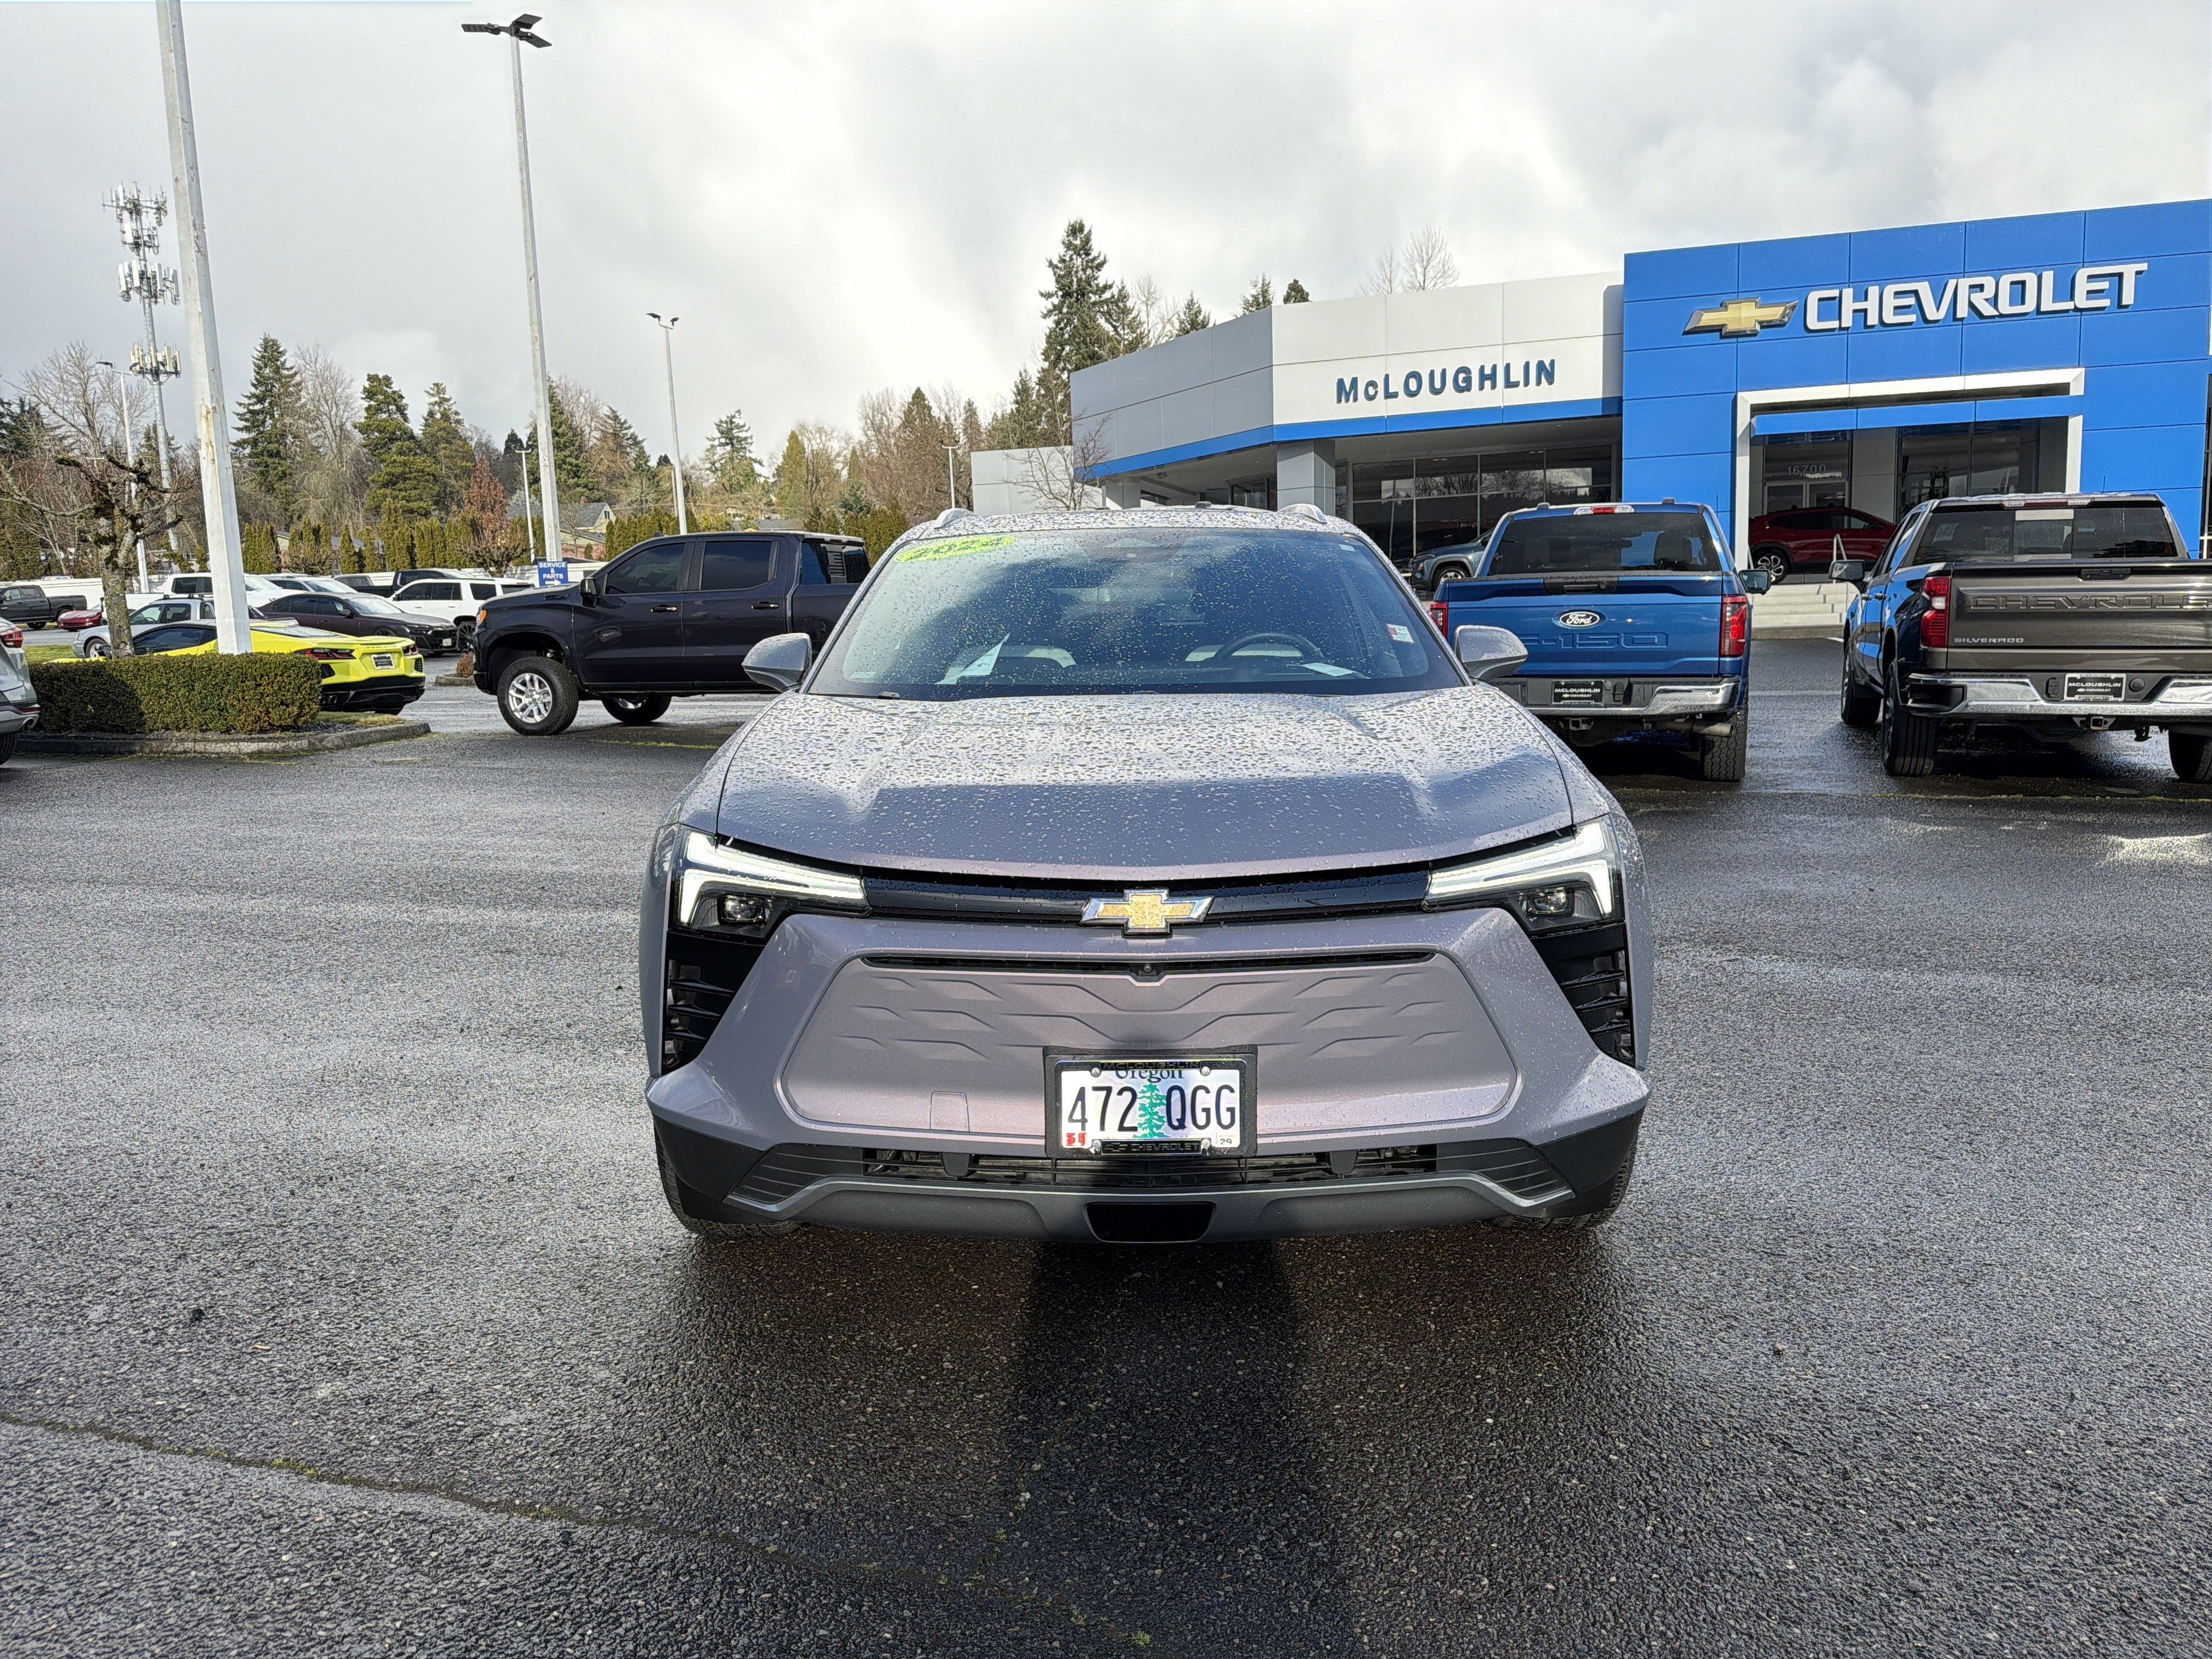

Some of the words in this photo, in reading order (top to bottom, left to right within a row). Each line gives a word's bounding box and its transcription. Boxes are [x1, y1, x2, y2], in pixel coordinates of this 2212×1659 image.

[1806, 262, 2148, 330] CHEVROLET
[1336, 358, 1556, 404] McLOUGHLIN
[1787, 464, 1826, 476] 16700
[1971, 595, 2212, 610] CHEVROLE
[1566, 613, 1592, 624] Ford
[1068, 1086, 1138, 1132] 472
[1166, 1084, 1235, 1130] QGG
[1130, 1143, 1200, 1152] CHEVROLET
